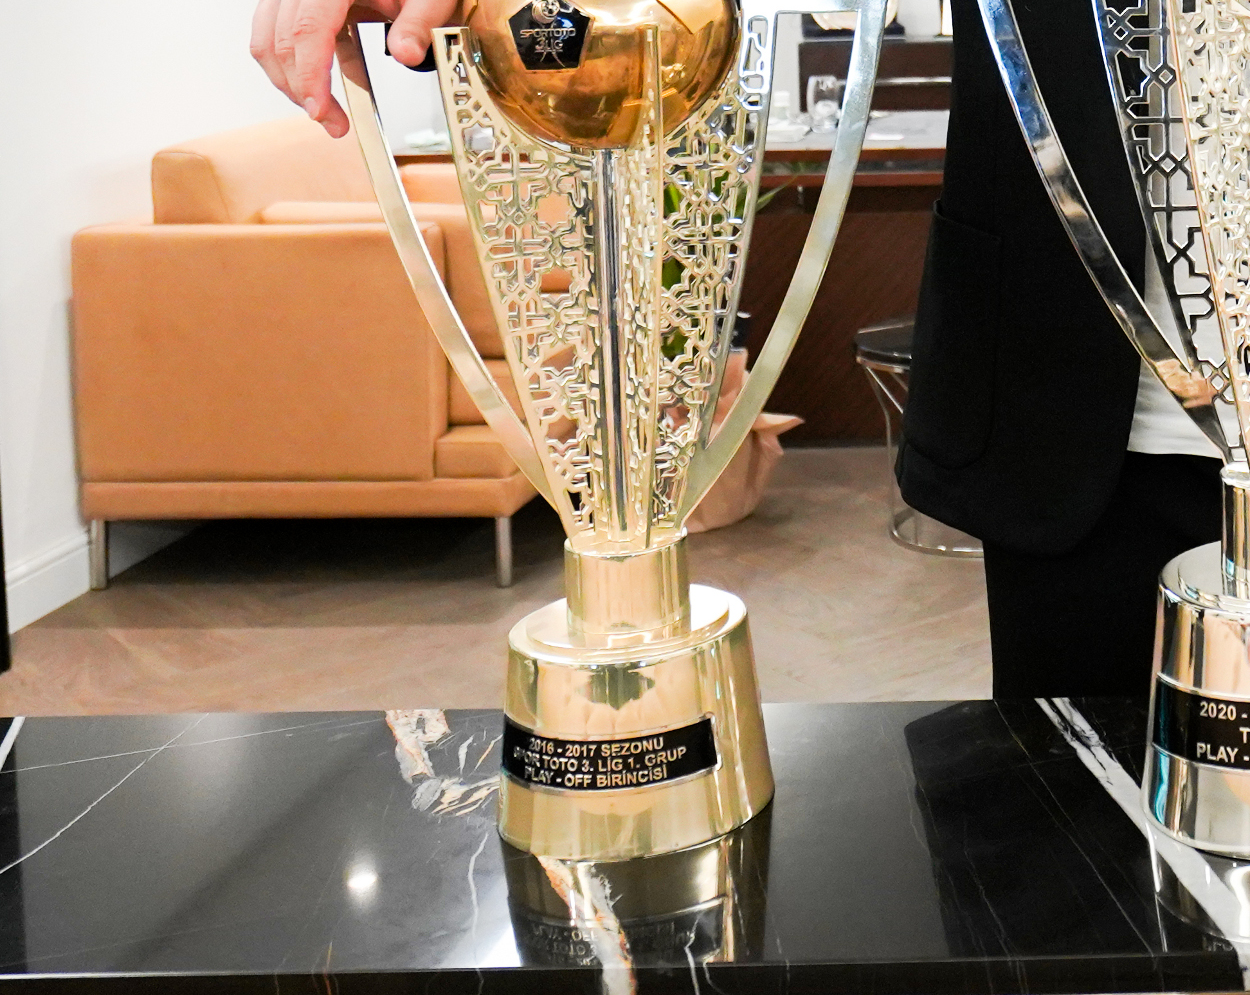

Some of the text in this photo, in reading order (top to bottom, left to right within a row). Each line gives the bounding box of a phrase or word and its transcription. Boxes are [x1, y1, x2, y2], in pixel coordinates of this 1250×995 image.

[1199, 701, 1237, 721] 2020
[565, 744, 597, 757] 2017
[601, 736, 664, 757] SEZONU
[1196, 742, 1239, 764] PLAY
[542, 754, 578, 772] TOTO
[582, 758, 594, 772] 3.
[598, 756, 623, 772] LİG
[628, 756, 640, 769] 1.
[644, 745, 687, 766] GRUP
[524, 765, 554, 784] PLAY
[564, 773, 593, 787] OFF
[596, 764, 668, 787] BİRİNCİSİ
